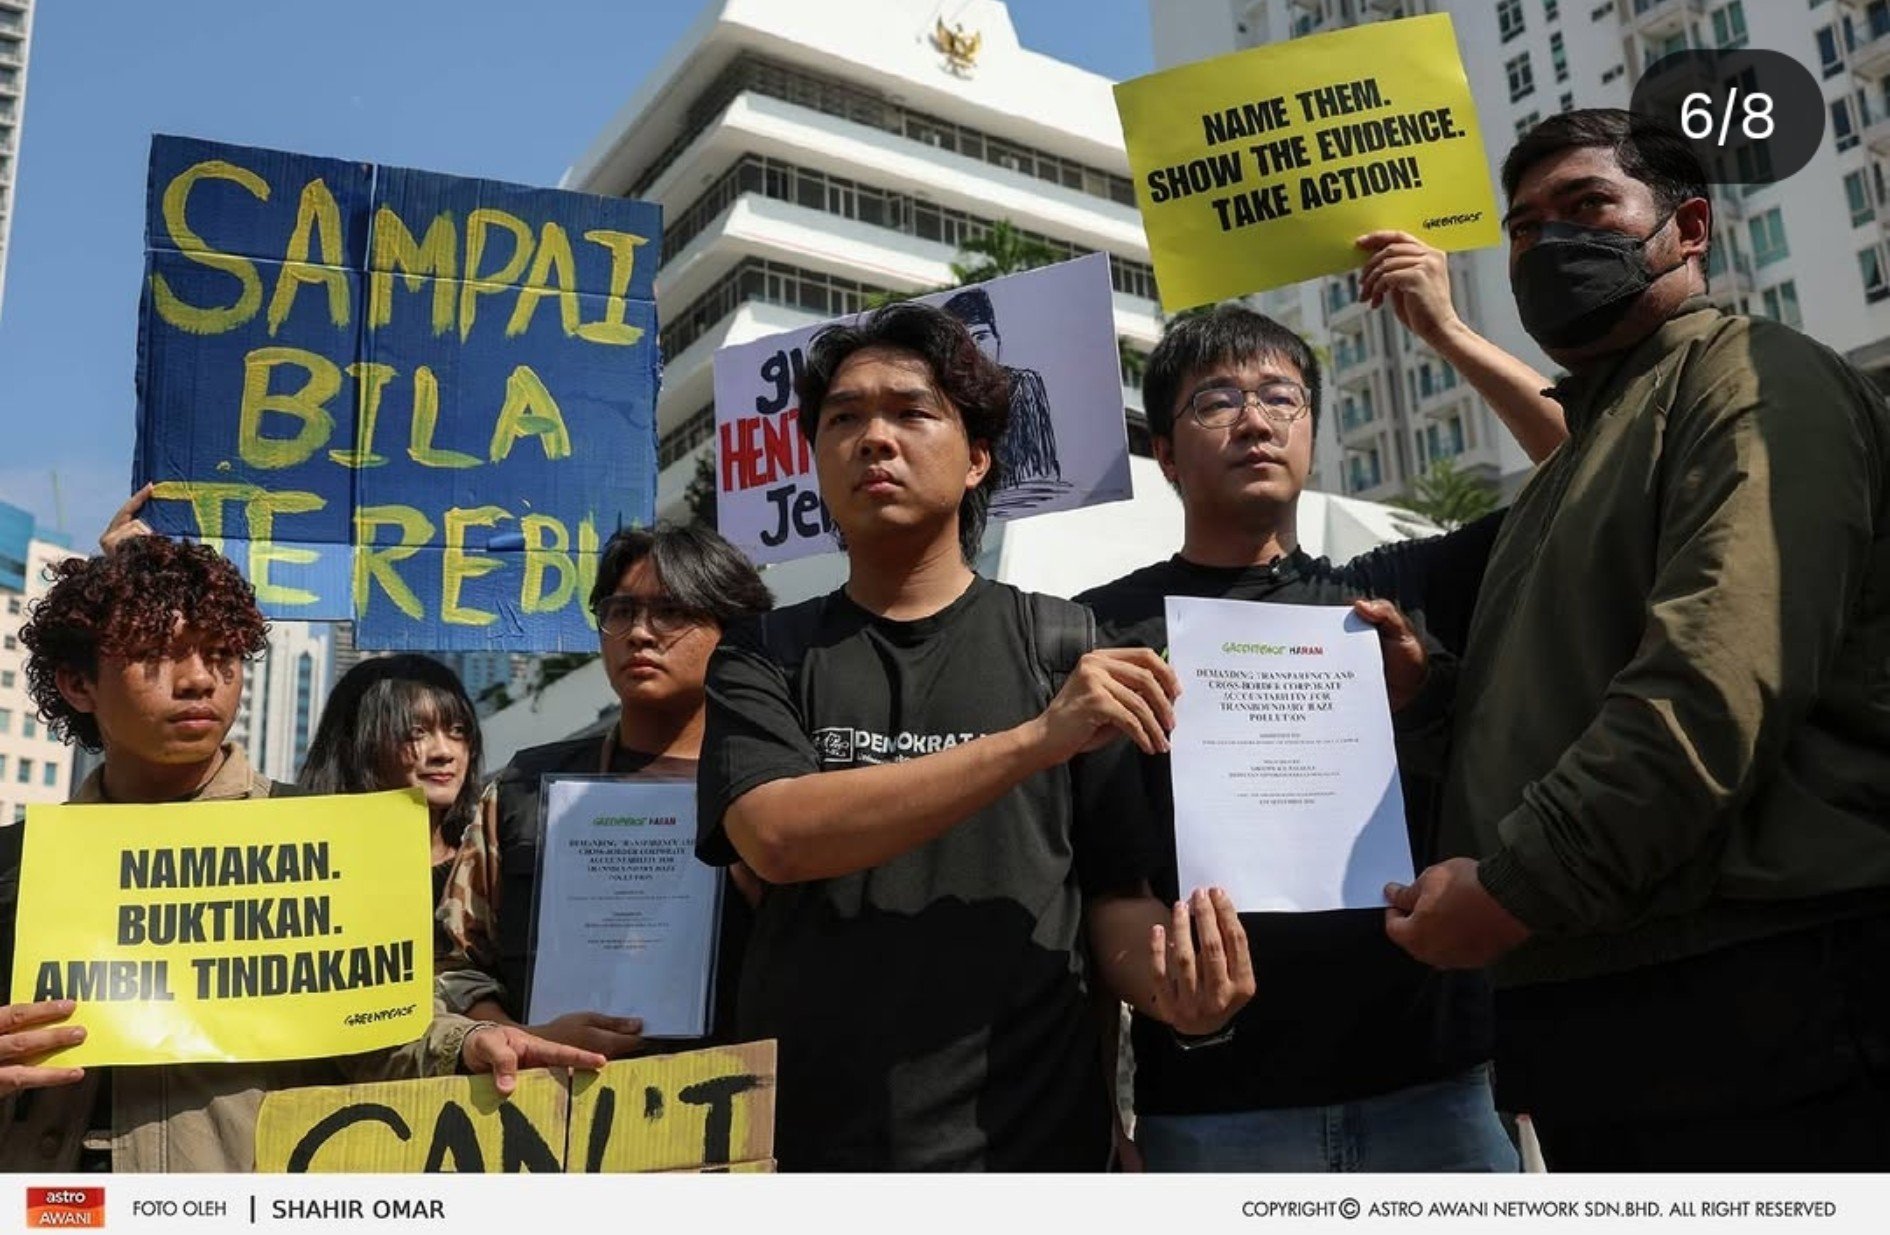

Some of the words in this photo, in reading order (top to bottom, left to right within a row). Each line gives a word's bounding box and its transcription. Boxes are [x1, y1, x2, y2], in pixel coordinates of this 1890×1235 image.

[1202, 97, 1290, 145] NAME
[1296, 78, 1391, 122] THEM.
[1147, 151, 1243, 203] SHOW
[1251, 136, 1311, 177] THE
[1316, 108, 1465, 159] EVIDENCE.
[1212, 184, 1292, 231] TAKE
[1300, 157, 1422, 211] ACTION!
[149, 160, 649, 346] SAMPAI
[239, 347, 571, 469] BILA
[120, 841, 341, 890] NAMAKAN.
[117, 896, 342, 945] BUKTIKAN.
[33, 959, 174, 1003] AMBIL
[191, 940, 414, 1001] TINDAKAN!
[344, 1004, 417, 1027] GREENPEACE
